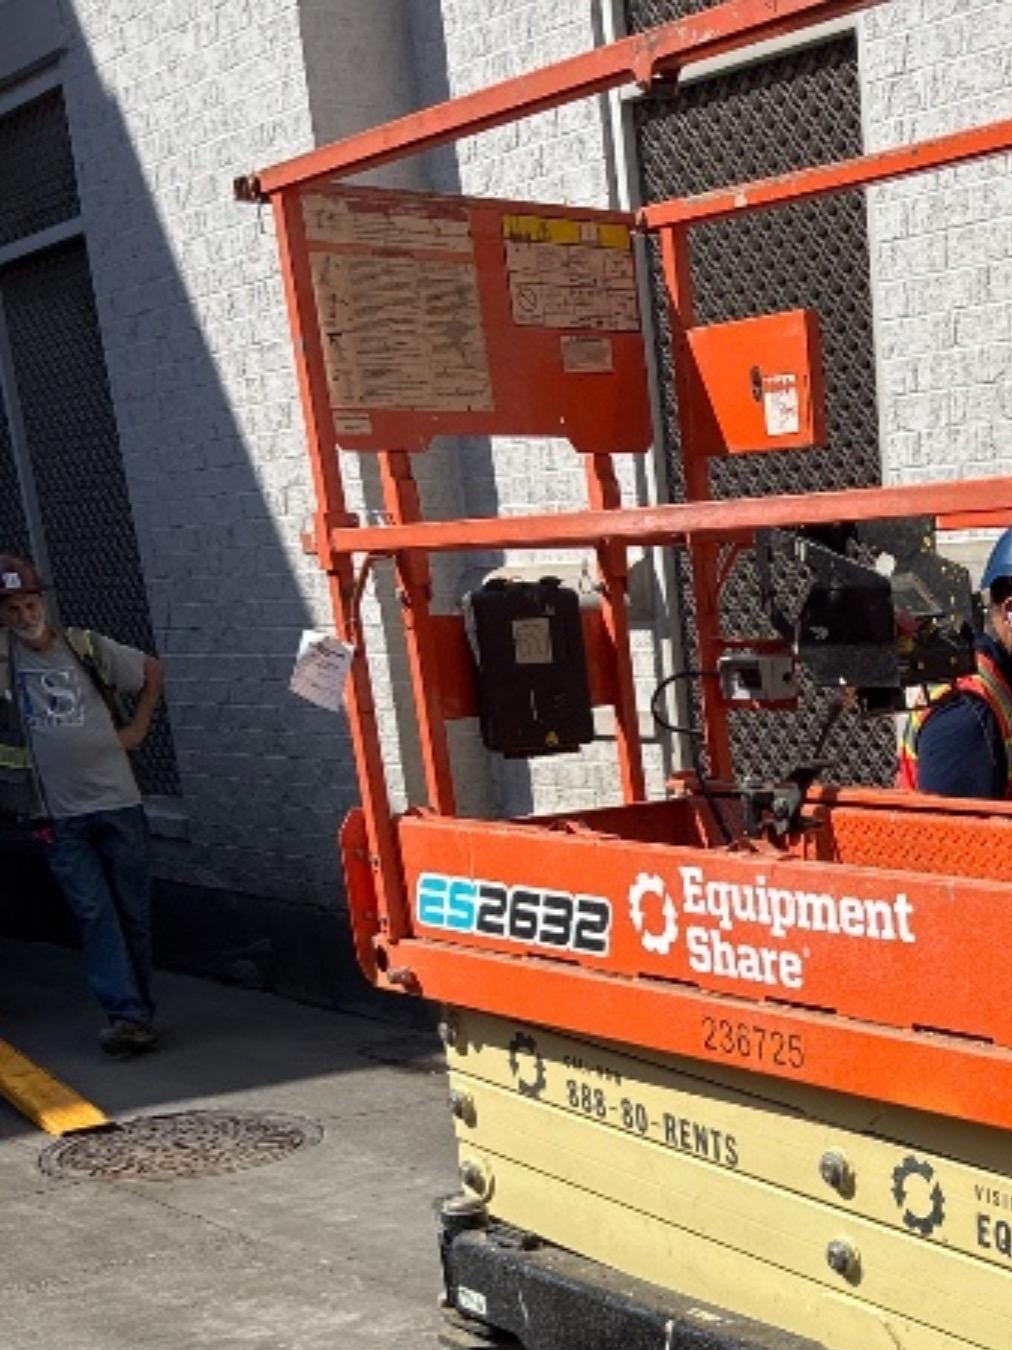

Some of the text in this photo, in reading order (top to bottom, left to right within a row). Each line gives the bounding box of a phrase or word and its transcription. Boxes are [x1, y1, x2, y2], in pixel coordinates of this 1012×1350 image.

[417, 873, 612, 957] ES2632
[678, 866, 915, 943] Equipment
[688, 926, 803, 989] Share
[700, 1015, 805, 1068] 236725
[566, 1079, 740, 1168] 888-80-RENTS
